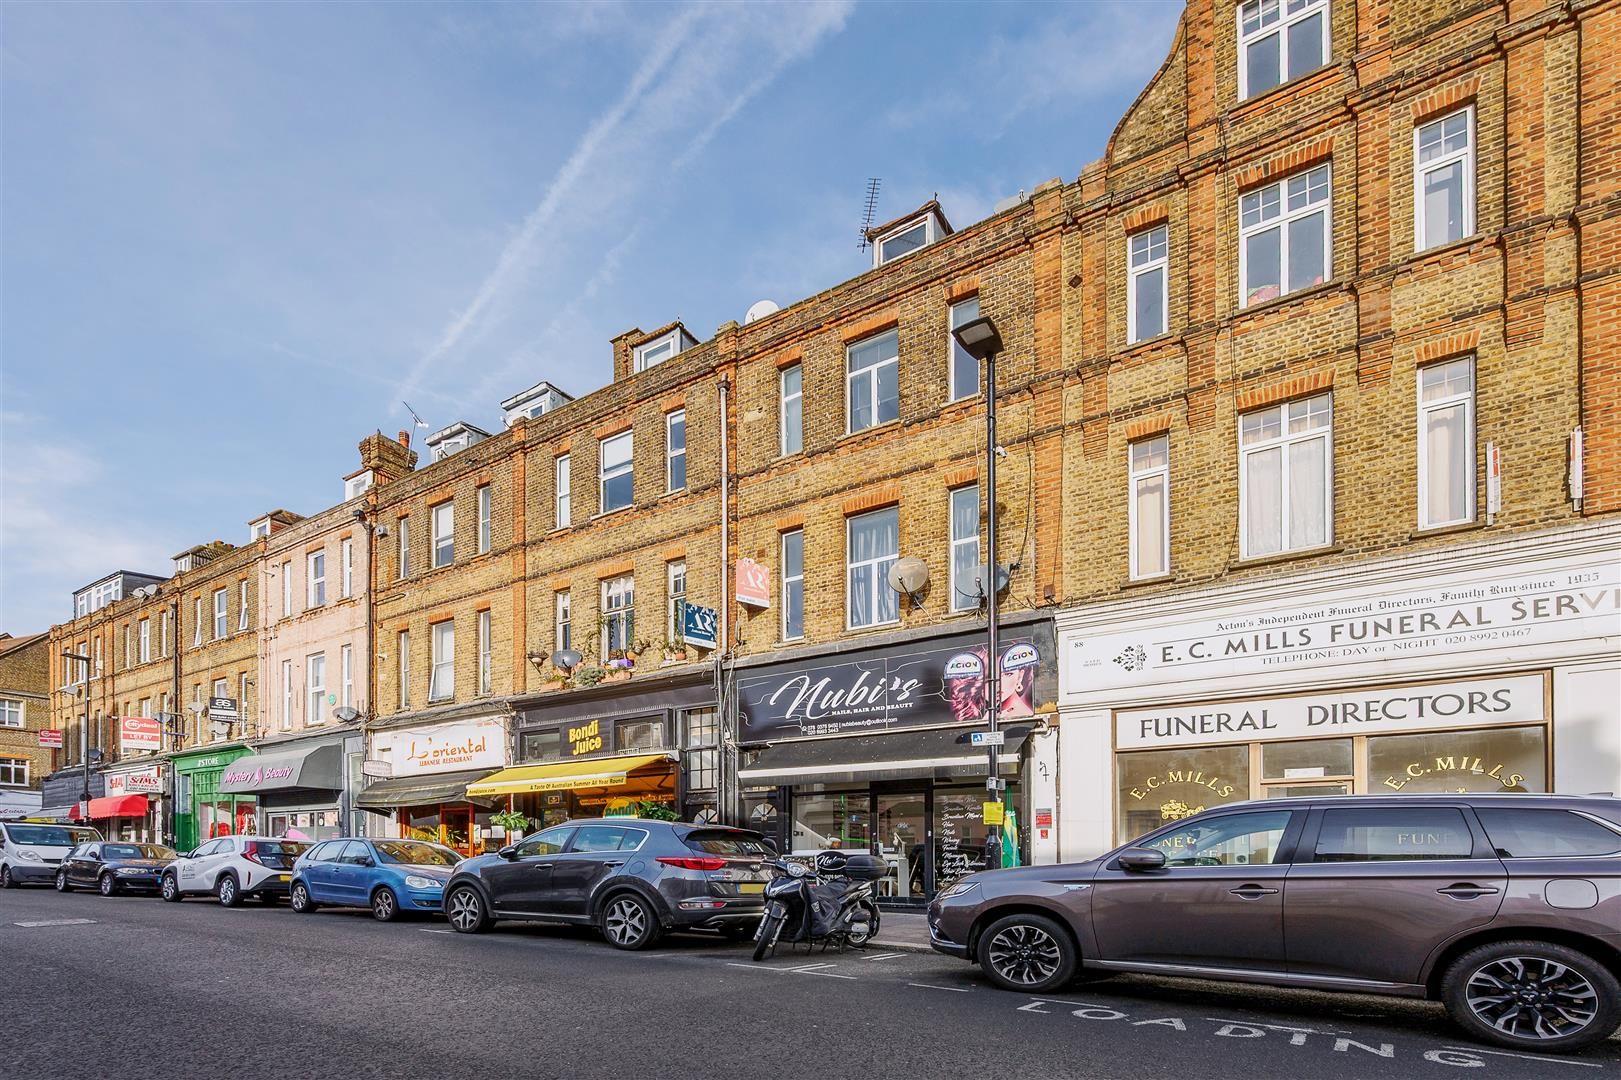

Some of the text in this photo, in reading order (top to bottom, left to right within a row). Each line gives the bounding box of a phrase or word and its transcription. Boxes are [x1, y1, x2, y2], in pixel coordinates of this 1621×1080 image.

[1216, 618, 1254, 632] Acton's
[1257, 611, 1325, 626] Independent
[1328, 603, 1373, 617] Funeral
[1378, 595, 1436, 610] Directors,
[1440, 589, 1485, 602] Family
[1224, 627, 1312, 656] MILLS
[1330, 606, 1492, 643] FUNERAL
[1261, 650, 1339, 665] TELEPHONE:
[1342, 645, 1371, 656] DAY
[1393, 639, 1440, 651] NIGHT
[1444, 635, 1467, 645] 020
[1469, 631, 1499, 642] 8992
[1501, 627, 1532, 638] 0467
[769, 671, 923, 720] Nubi's
[1140, 689, 1512, 738] FUNERAL DIRECTORS
[568, 719, 599, 744] Bondi
[573, 736, 602, 756] Juice
[407, 735, 487, 761] L'oriental
[225, 765, 294, 786] Mystery Beauty
[551, 781, 573, 789] Australian
[573, 780, 591, 788] Summer
[1168, 770, 1235, 798] MILLS
[1435, 756, 1524, 788] MILLS
[1016, 1001, 1486, 1068] LOADING
